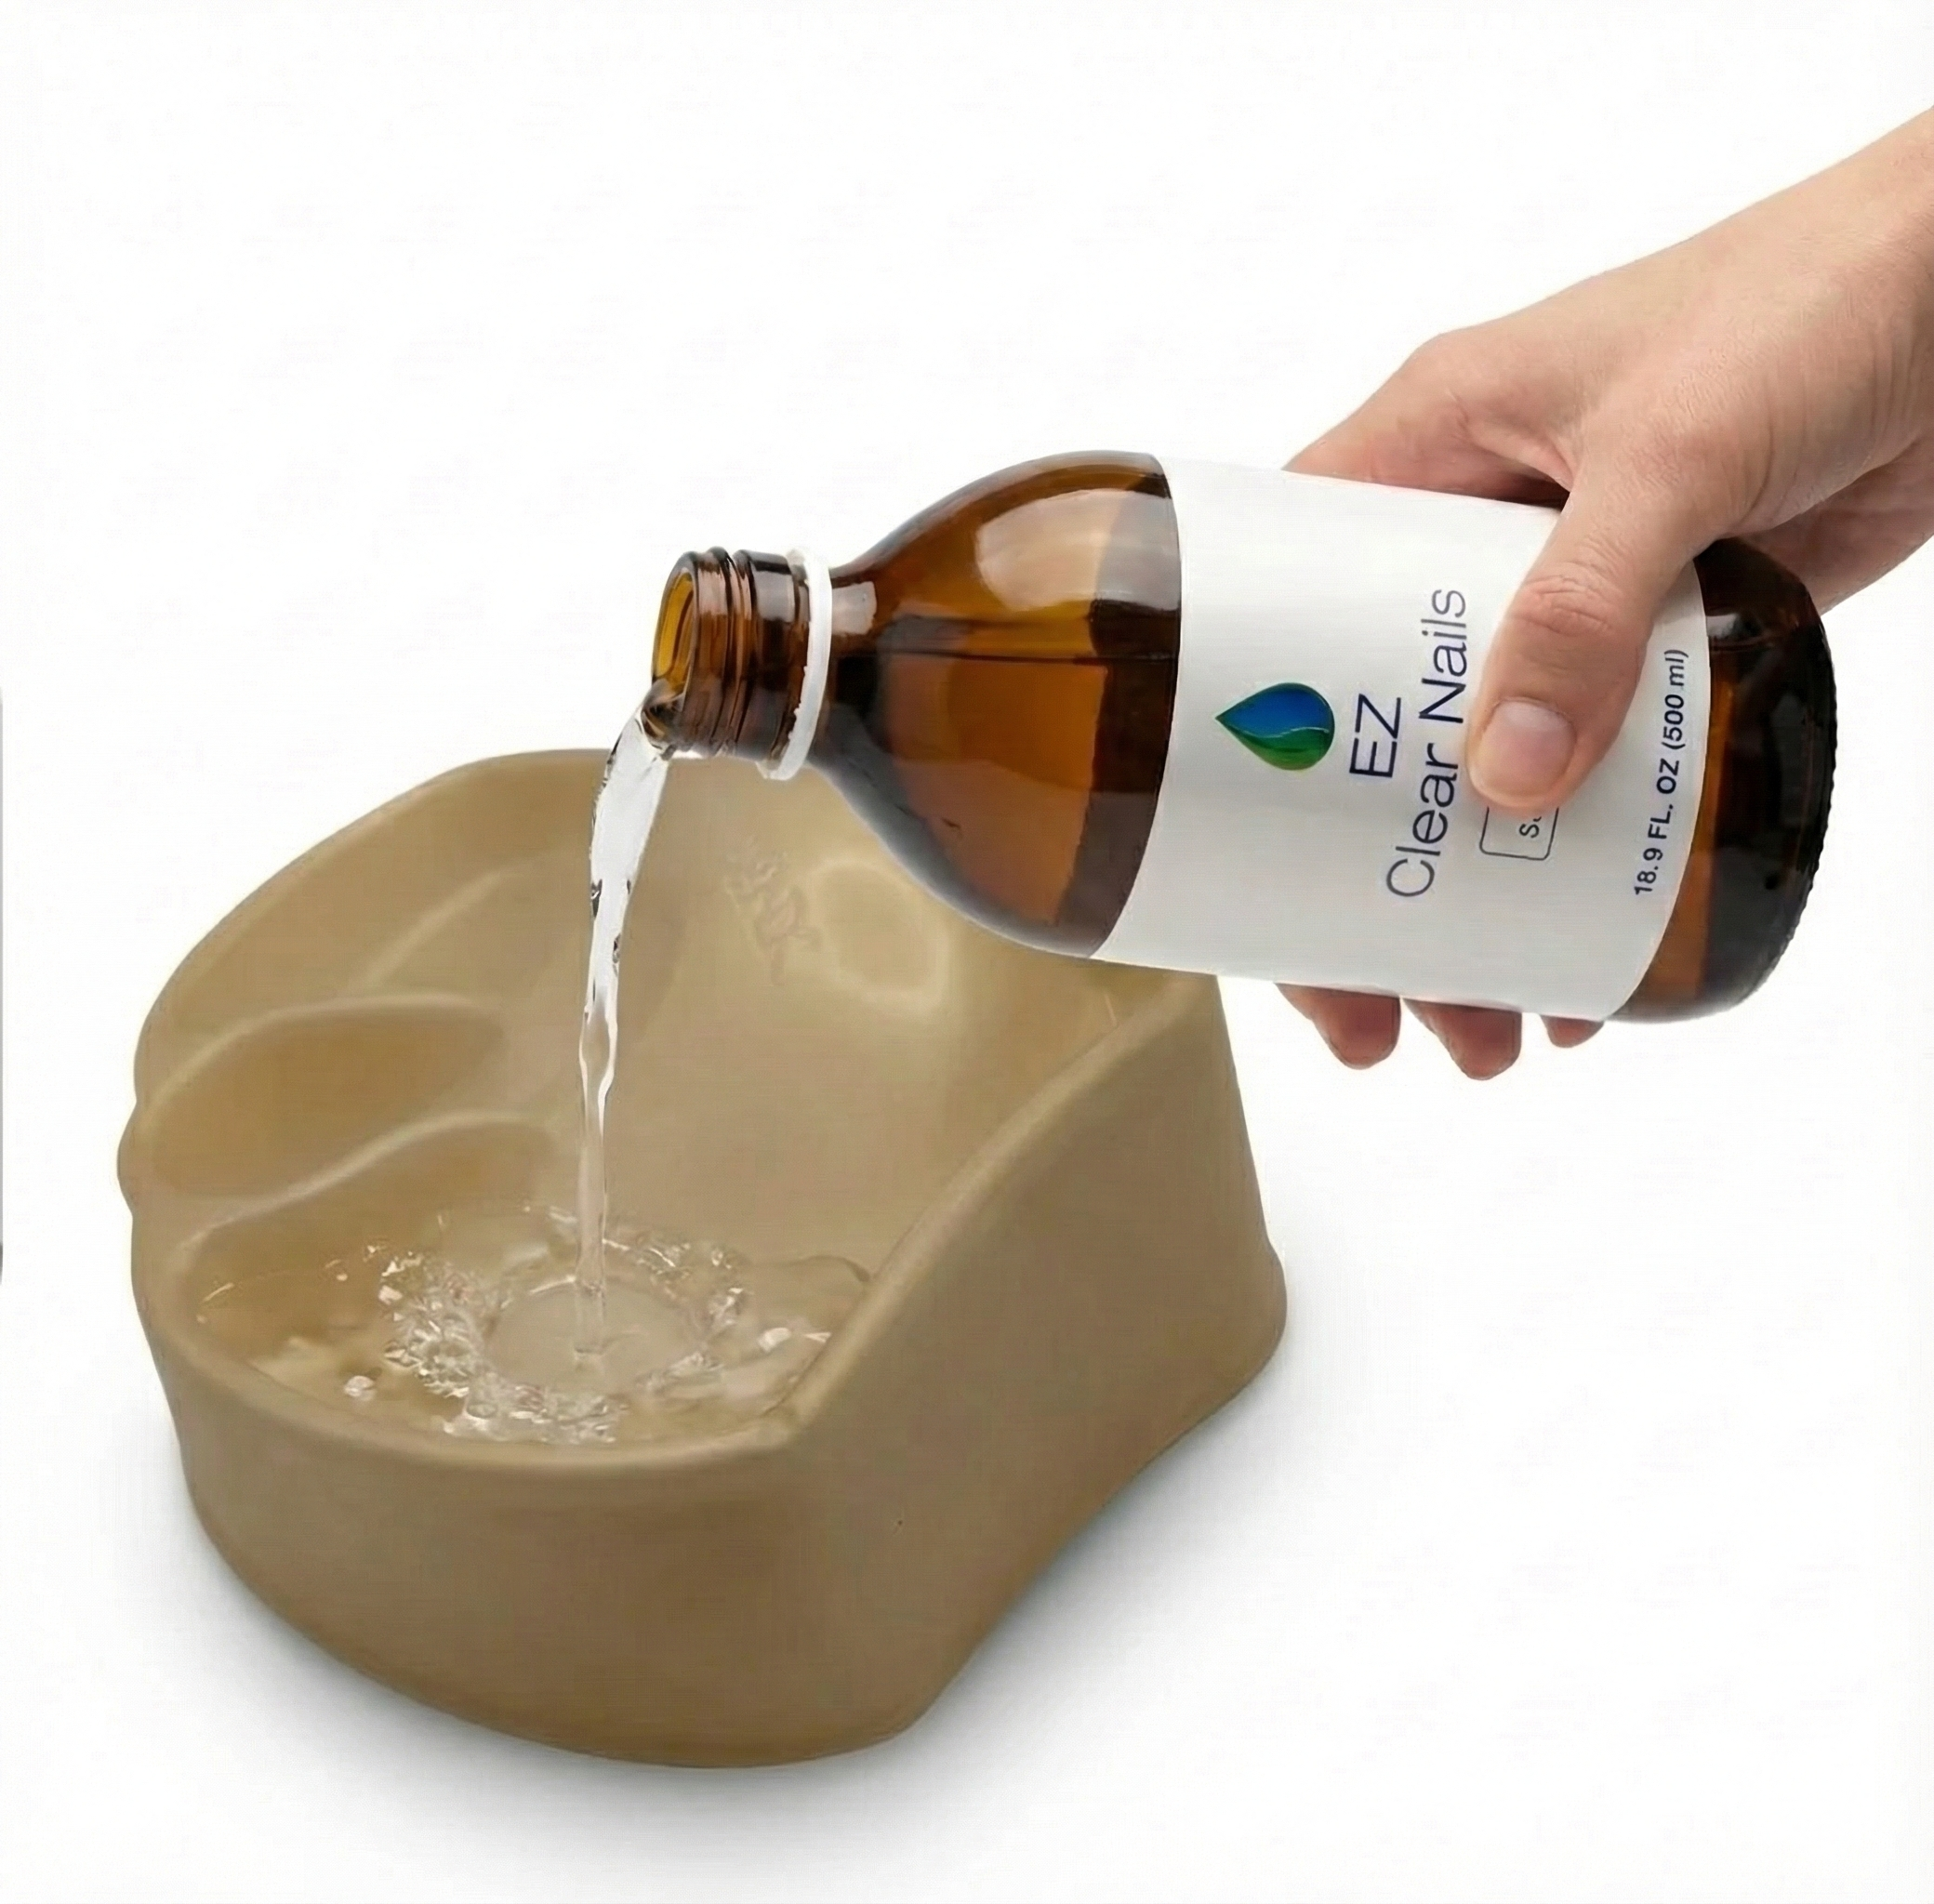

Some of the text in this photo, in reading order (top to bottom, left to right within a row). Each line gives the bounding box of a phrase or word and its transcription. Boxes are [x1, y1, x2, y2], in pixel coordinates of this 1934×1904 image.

[1348, 693, 1402, 779] EZ
[1385, 588, 1468, 897] Clear Nails
[1633, 648, 1689, 895] 18.9 FL. OZ (500 ml)
[1517, 814, 1543, 840] S
